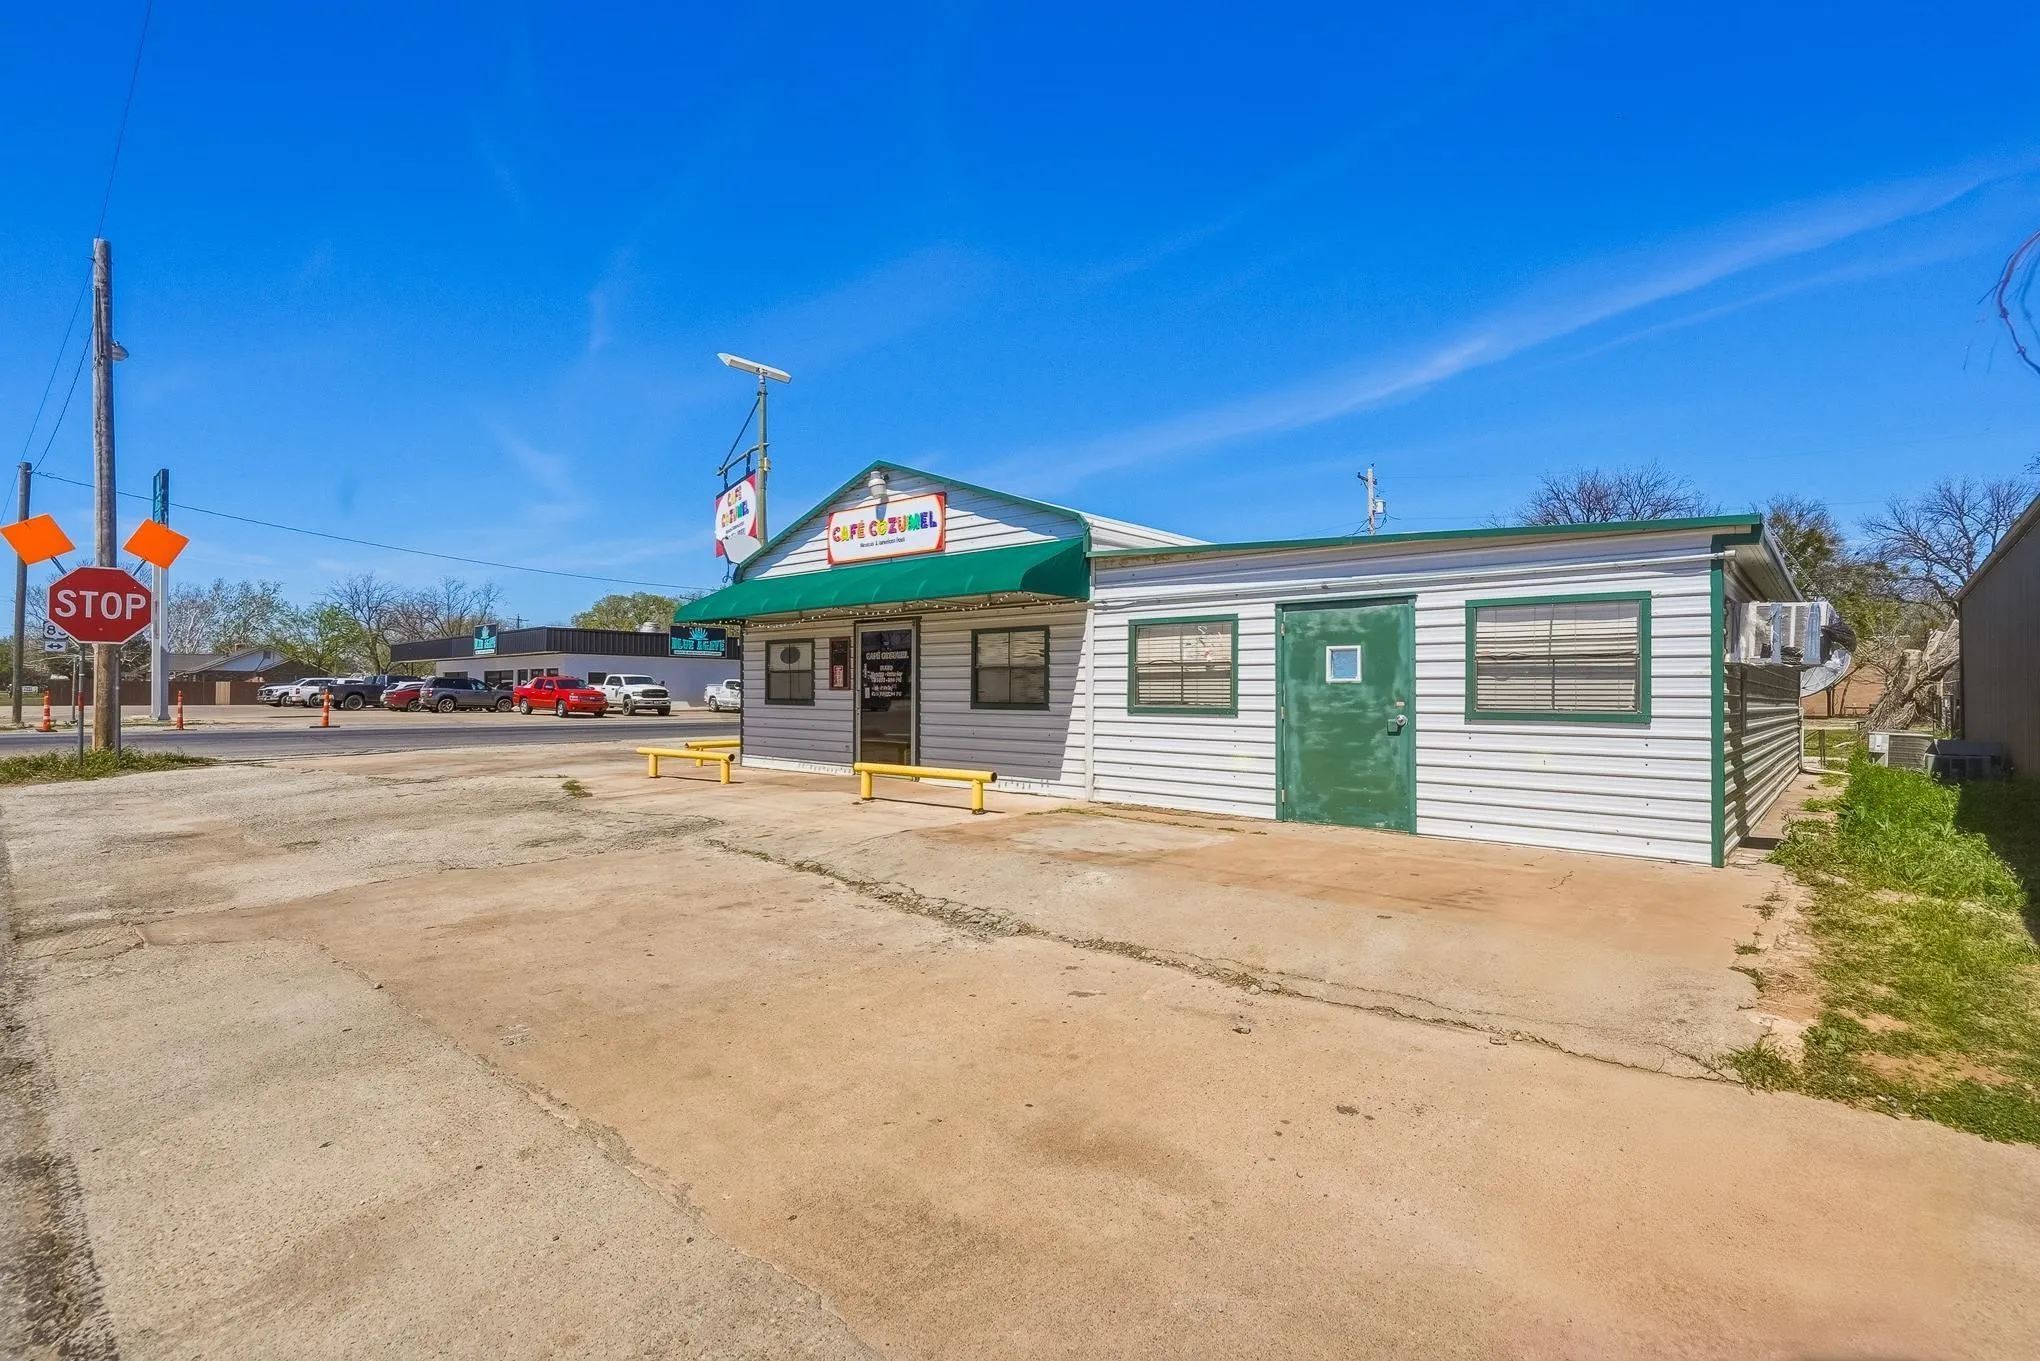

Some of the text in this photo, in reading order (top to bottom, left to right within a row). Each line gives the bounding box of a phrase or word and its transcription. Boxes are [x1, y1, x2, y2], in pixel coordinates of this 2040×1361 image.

[833, 511, 937, 542] CAFÉ COZUMEL
[55, 589, 146, 620] STOP
